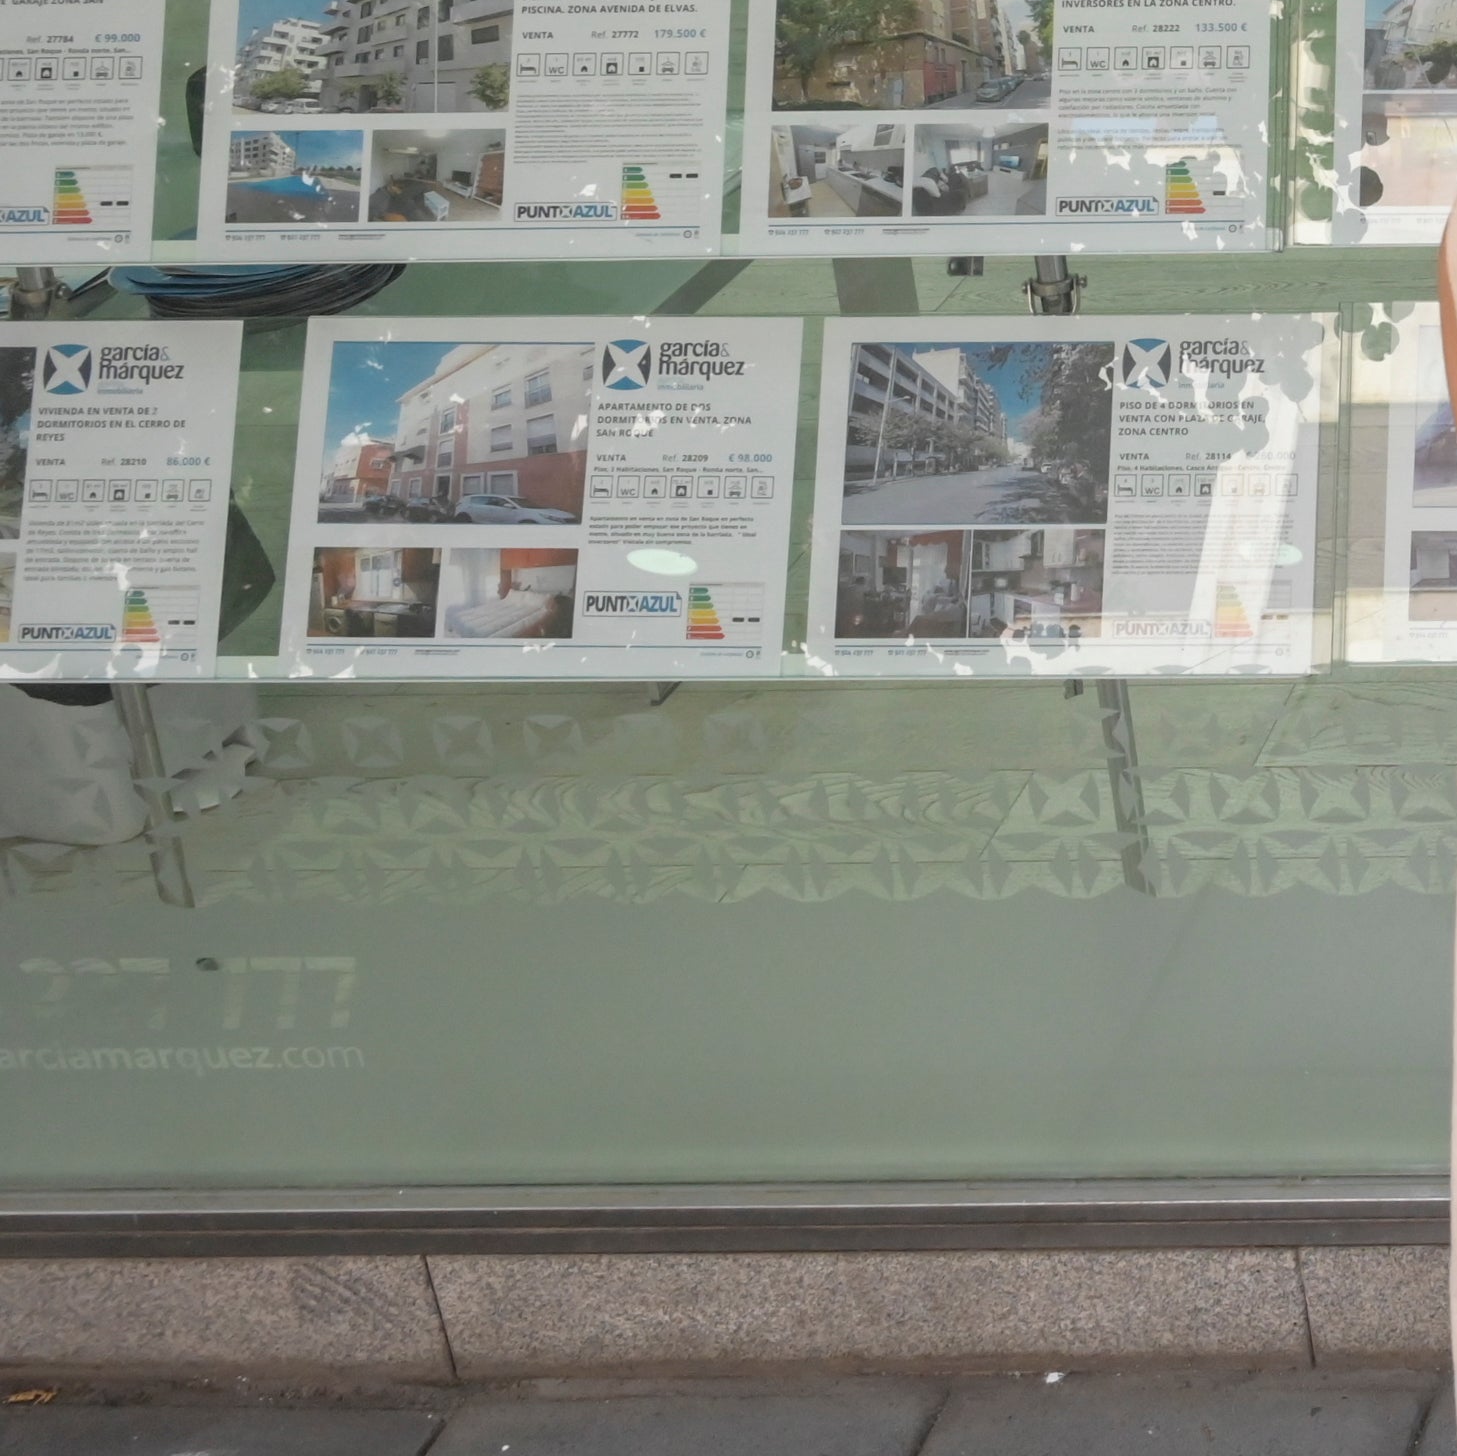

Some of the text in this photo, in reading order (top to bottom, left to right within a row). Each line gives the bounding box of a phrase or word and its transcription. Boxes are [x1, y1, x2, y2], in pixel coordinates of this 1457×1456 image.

[611, 30, 639, 39] 27772
[658, 358, 745, 382] márquez
[1118, 427, 1189, 436] ZONA CENTRO
[36, 433, 65, 442] REYES
